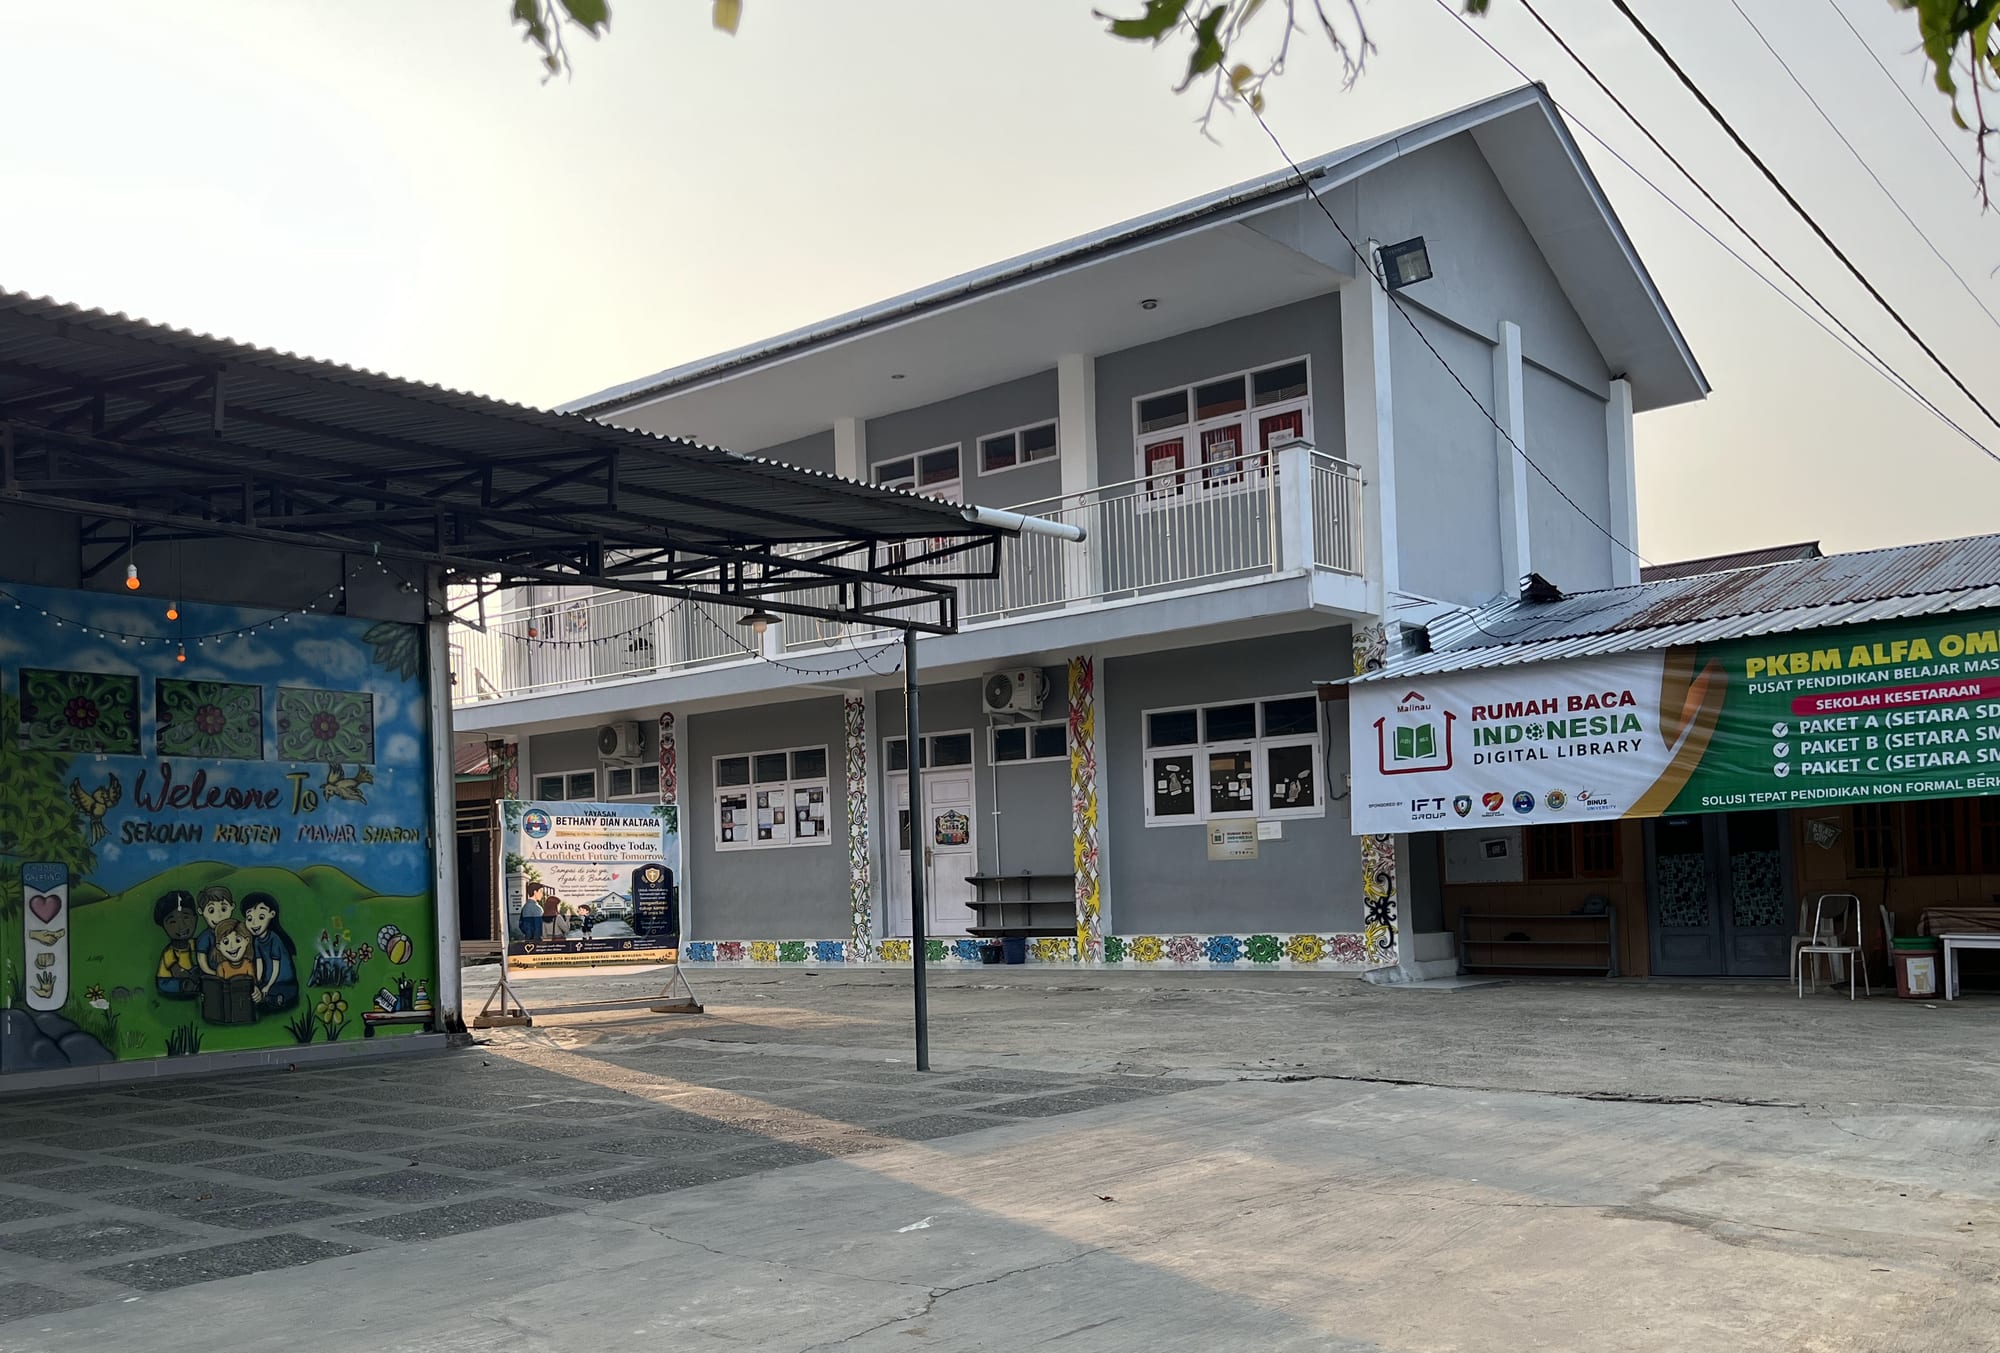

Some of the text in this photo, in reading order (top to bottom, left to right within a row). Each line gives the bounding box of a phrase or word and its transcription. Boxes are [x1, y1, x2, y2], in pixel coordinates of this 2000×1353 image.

[1746, 629, 2000, 679] PKBM ALFA OM
[1749, 658, 2000, 695] PUSAT PENDIDIKAN BELAJAR MAS
[1397, 704, 1432, 713] Malinau
[1472, 690, 1637, 721] RUMAH BACA
[1816, 684, 1980, 710] SEKOLAH KESETARAAN
[1800, 716, 1859, 735] PAKET
[1864, 715, 1879, 729] A
[1885, 707, 1970, 729] (SETARA
[1474, 738, 1642, 765] DIGITAL LIBRARY
[1801, 737, 1860, 755] PAKET
[1866, 736, 1879, 750] B
[1885, 728, 1970, 750] (SETARA
[1802, 758, 1860, 775] PAKET
[1867, 757, 1879, 771] C
[1885, 750, 1971, 772] (SETARA
[135, 762, 318, 816] Welcome To
[1702, 794, 1746, 806] SOLUSI
[1749, 791, 1787, 802] TEPAT
[1791, 786, 1869, 800] PENDIDIKAN
[1873, 783, 1902, 795] NON
[1906, 780, 1964, 793] FORMAL
[1411, 797, 1445, 812] IFT
[1411, 812, 1446, 820] GROUP
[121, 821, 420, 846] SEKOLAH KRISTEN MAWAR SHARON
[556, 816, 660, 827] BETHANY DIAN KALTARA
[959, 821, 965, 830] 2
[530, 851, 537, 860] A
[539, 851, 585, 861] Confident
[588, 852, 618, 861] Future
[536, 841, 658, 853] A Loving Goodbye Today,
